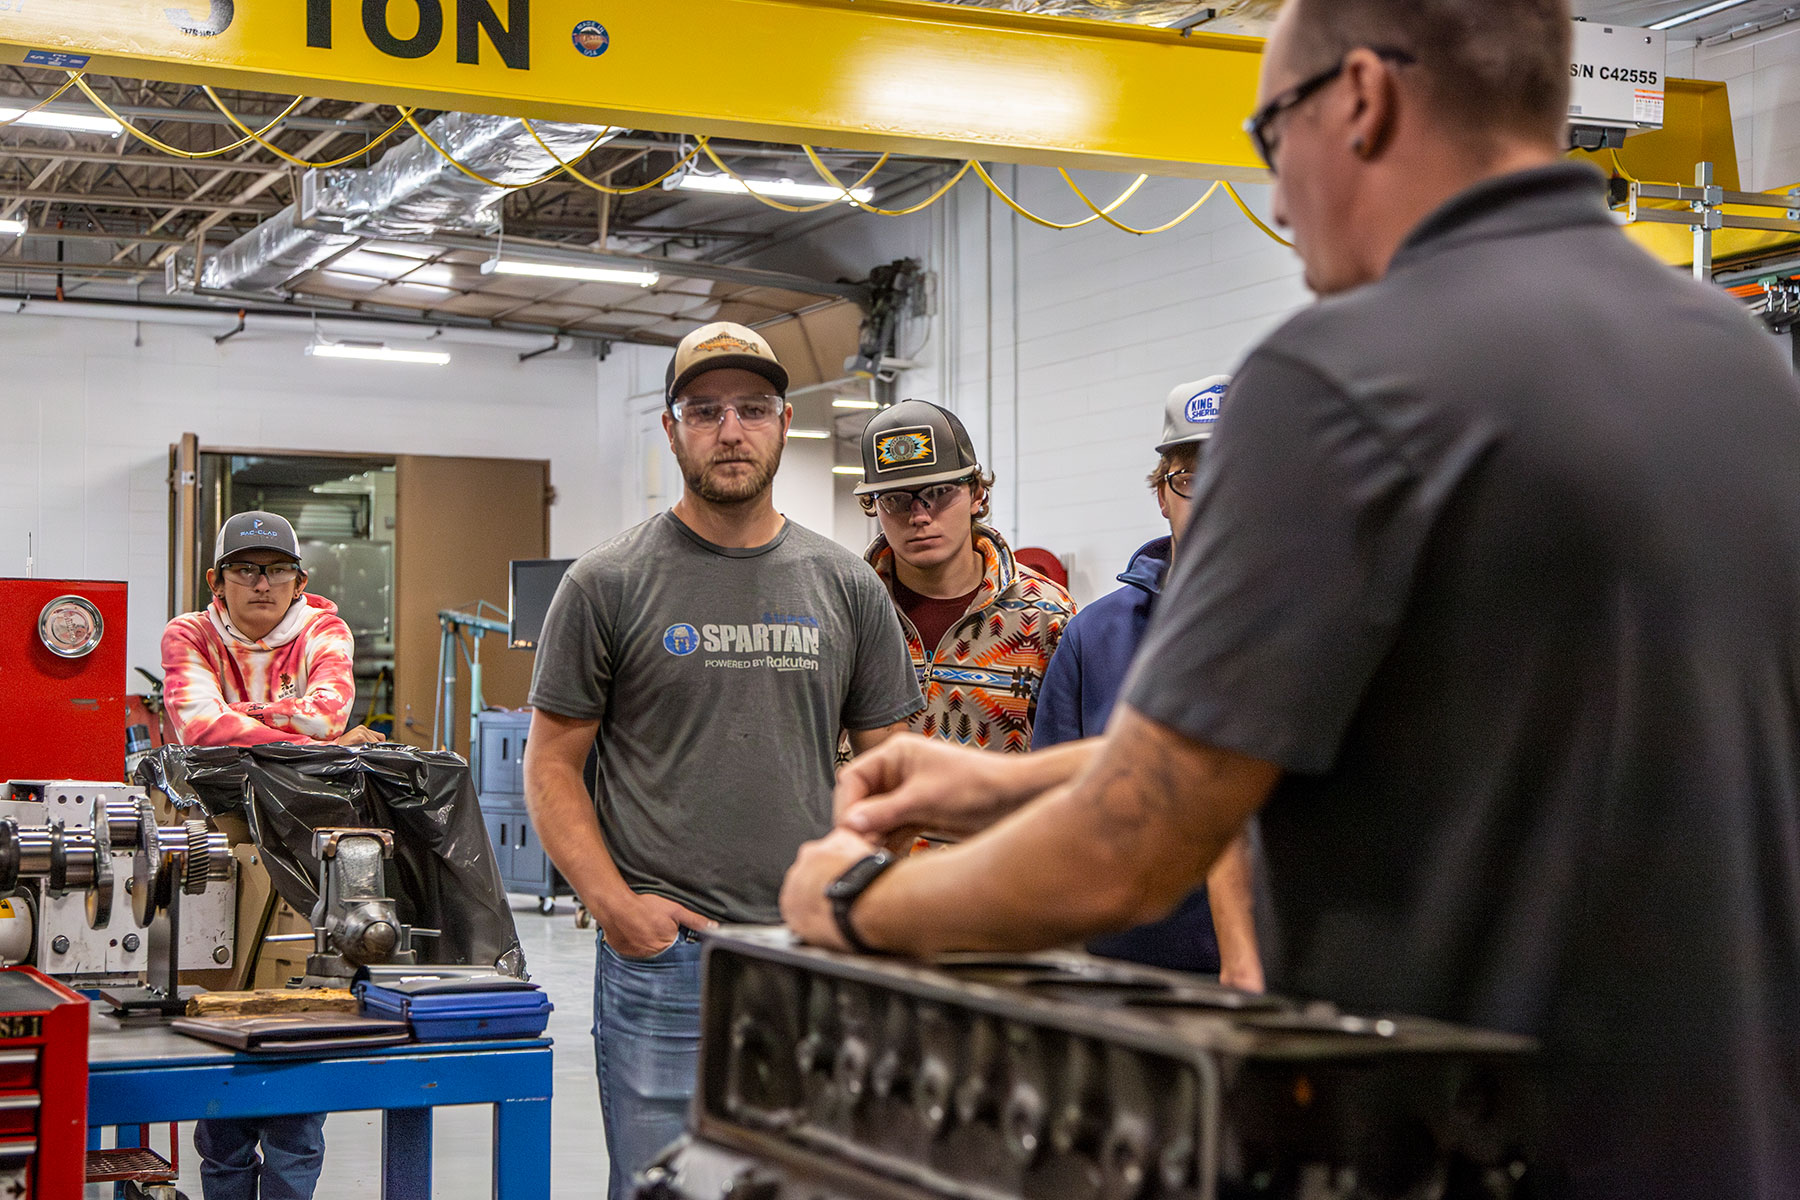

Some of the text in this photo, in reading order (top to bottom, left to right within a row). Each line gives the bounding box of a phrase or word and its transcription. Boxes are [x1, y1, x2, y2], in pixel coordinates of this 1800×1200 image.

[1570, 63, 1657, 85] S/N C42555
[1191, 397, 1212, 411] KING
[702, 624, 819, 655] SPARTAN
[705, 656, 819, 671] POWERED BY Rakuten
